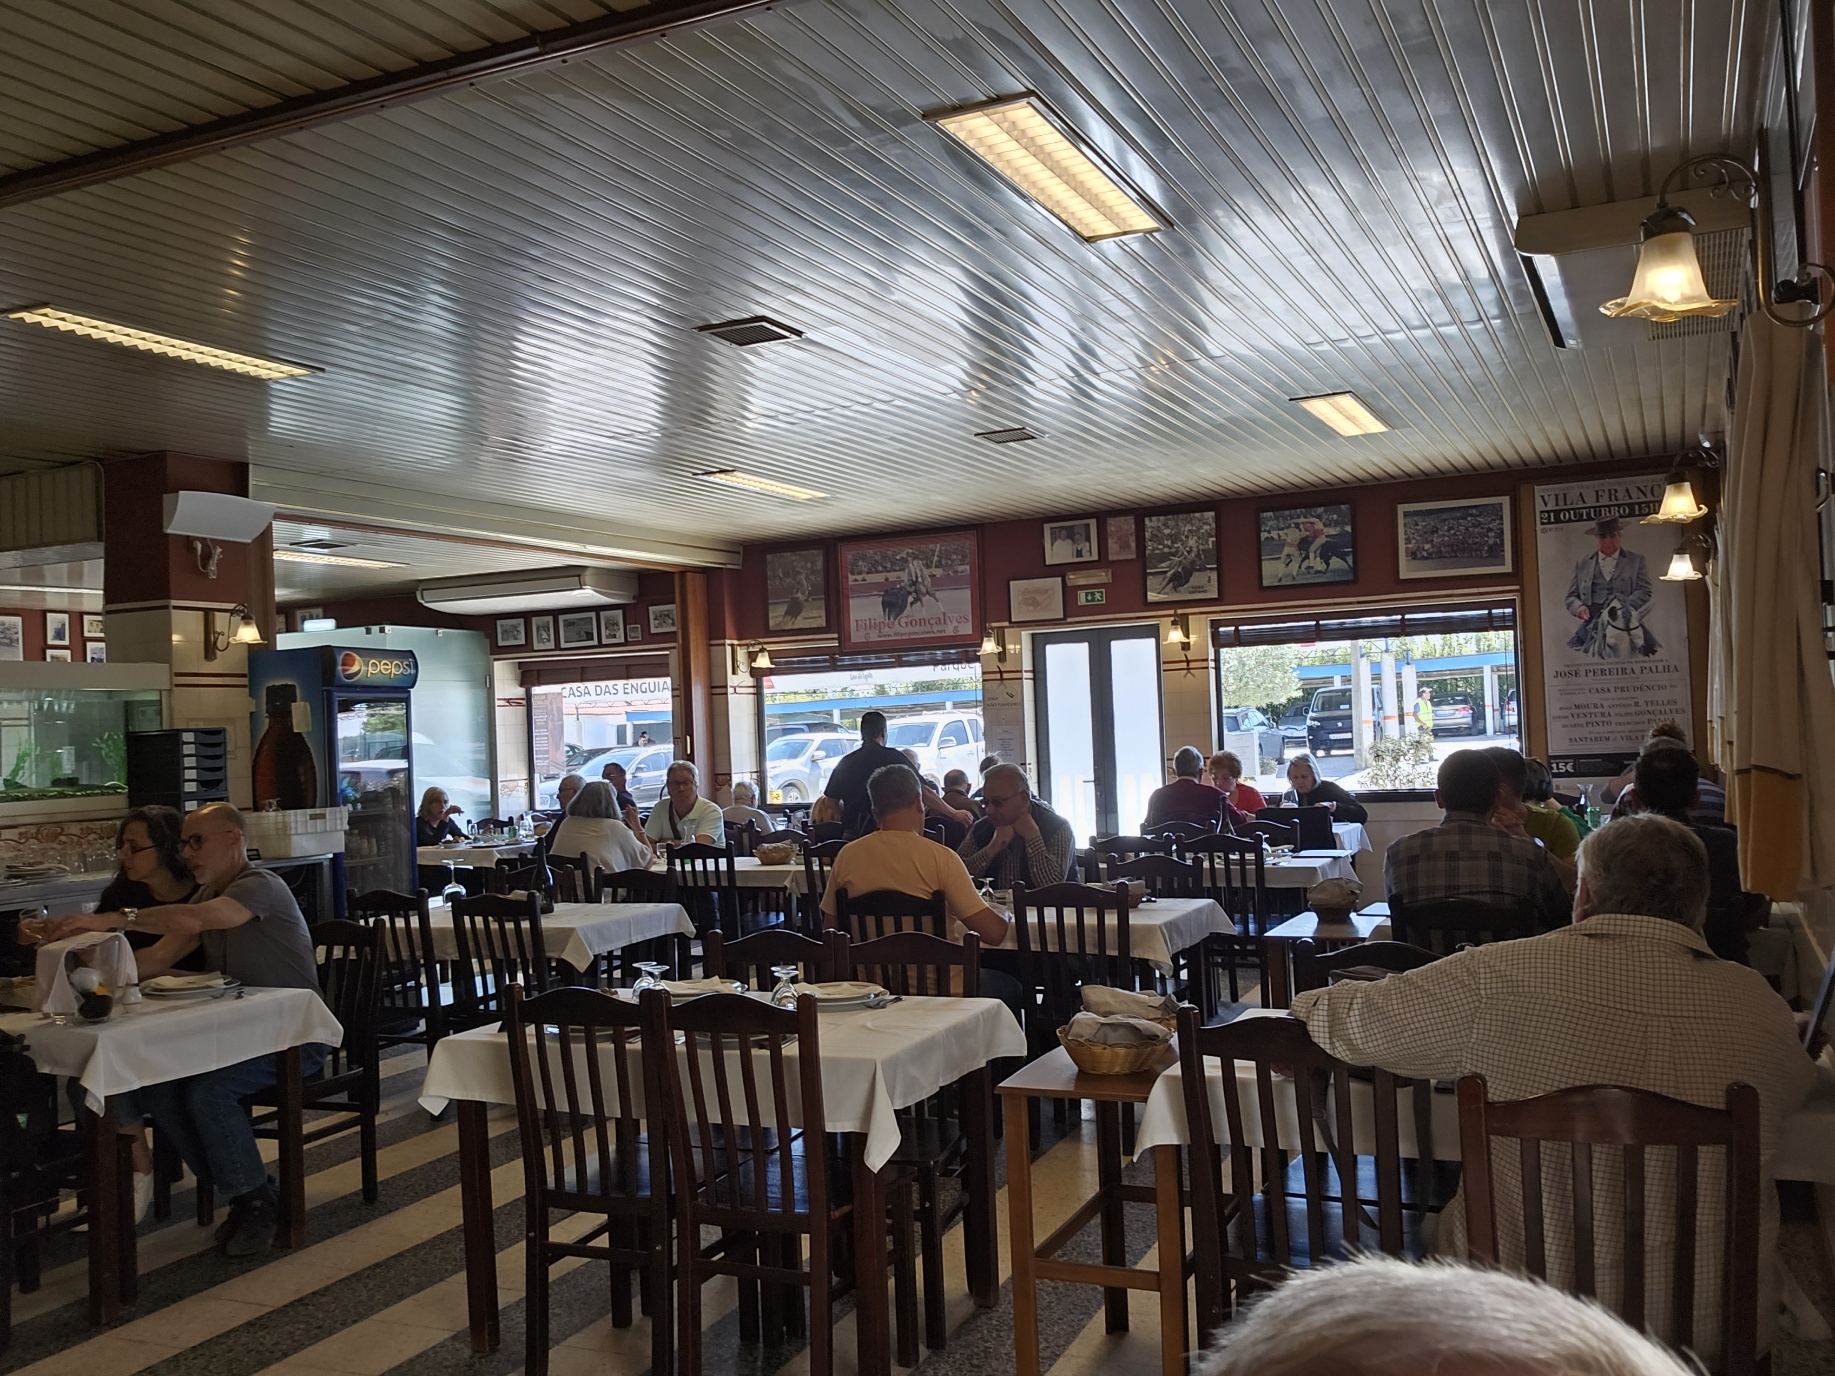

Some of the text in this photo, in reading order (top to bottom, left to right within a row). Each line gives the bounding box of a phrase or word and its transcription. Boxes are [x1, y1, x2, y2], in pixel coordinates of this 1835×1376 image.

[1539, 484, 1662, 508] VILA FRANC
[1541, 511, 1555, 523] 21
[1560, 506, 1629, 522] OUTUBRO
[855, 617, 895, 633] Filipe
[898, 612, 970, 629] Gonçalves
[367, 658, 414, 678] pepsi
[1553, 667, 1581, 679] JOSÉ
[1585, 666, 1636, 678] PEREIRA
[1640, 664, 1680, 675] PALHA
[561, 685, 591, 699] CASA
[594, 683, 619, 696] DAS
[623, 681, 670, 694] ENGUIA
[1588, 685, 1611, 694] CASA
[1614, 684, 1668, 693] PRUDÊNCIO
[1574, 702, 1605, 710] MOURA
[1644, 698, 1678, 707] TELLES
[1570, 711, 1612, 719] VENTURA
[1634, 707, 1686, 718] GONÇALVES
[1585, 719, 1613, 728] PINTO
[1568, 735, 1611, 744] SANTARÉM
[1620, 734, 1640, 742] VILA
[1551, 762, 1575, 773] 15€
